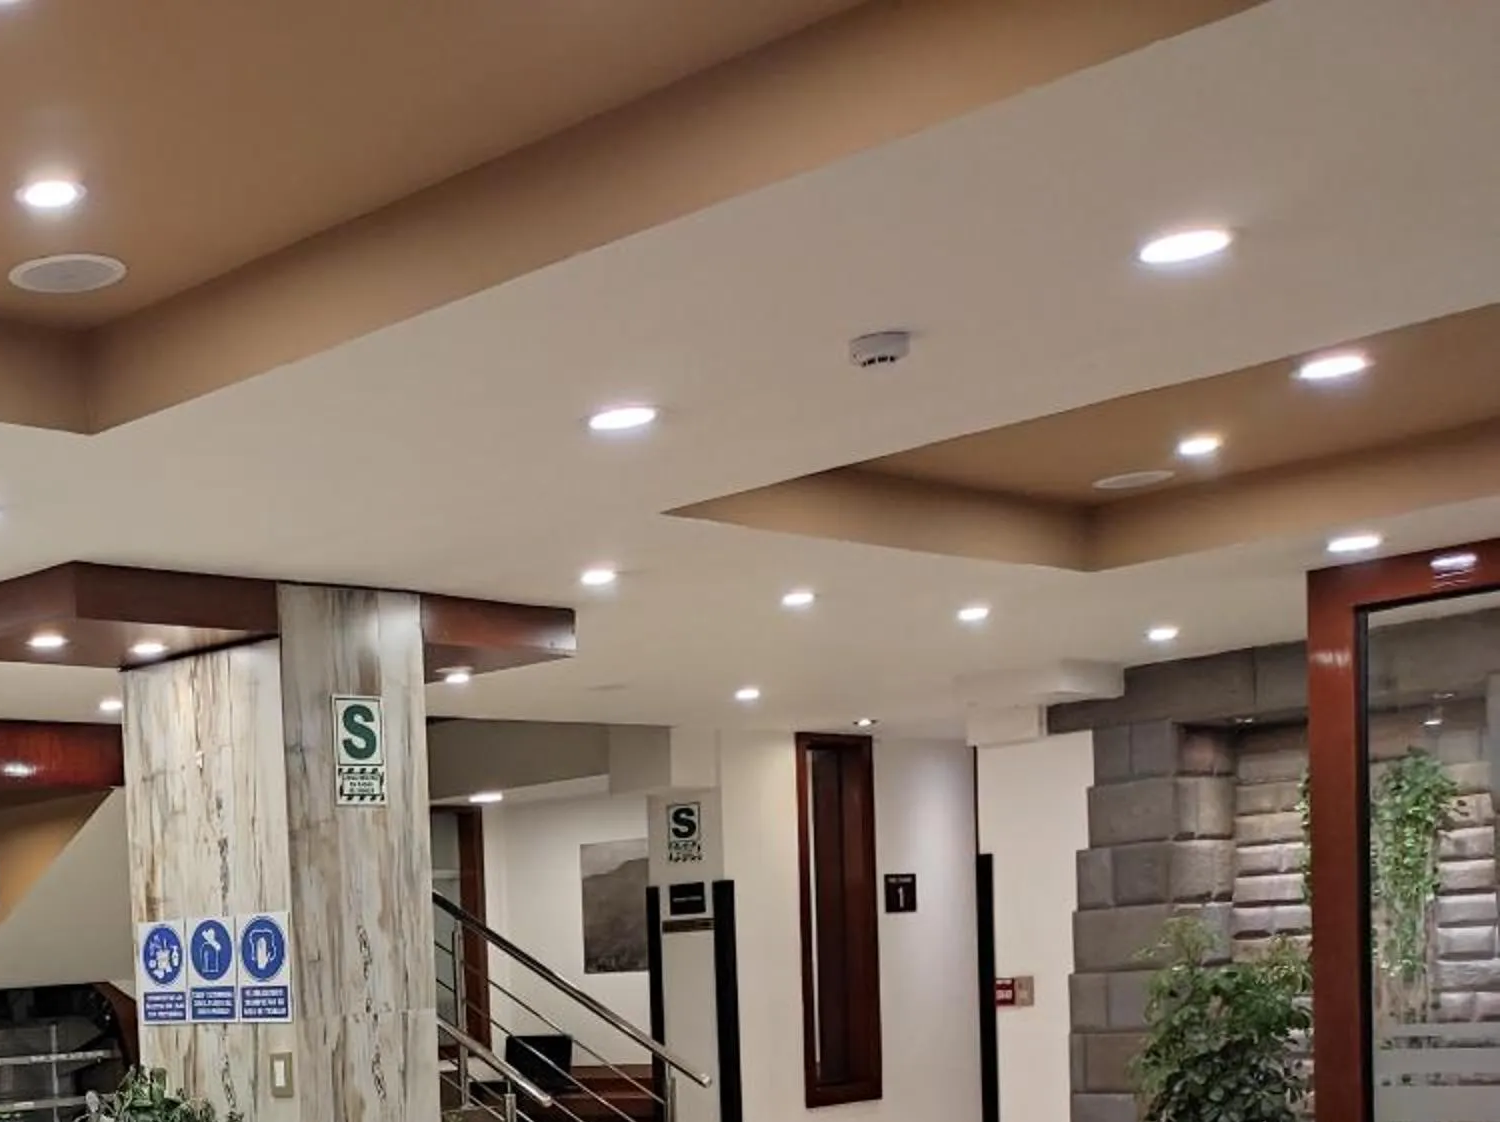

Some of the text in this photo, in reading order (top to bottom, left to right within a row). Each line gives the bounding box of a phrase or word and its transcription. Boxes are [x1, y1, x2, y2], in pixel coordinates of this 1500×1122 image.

[343, 704, 377, 760] S
[672, 807, 697, 839] S
[897, 886, 905, 909] 1
